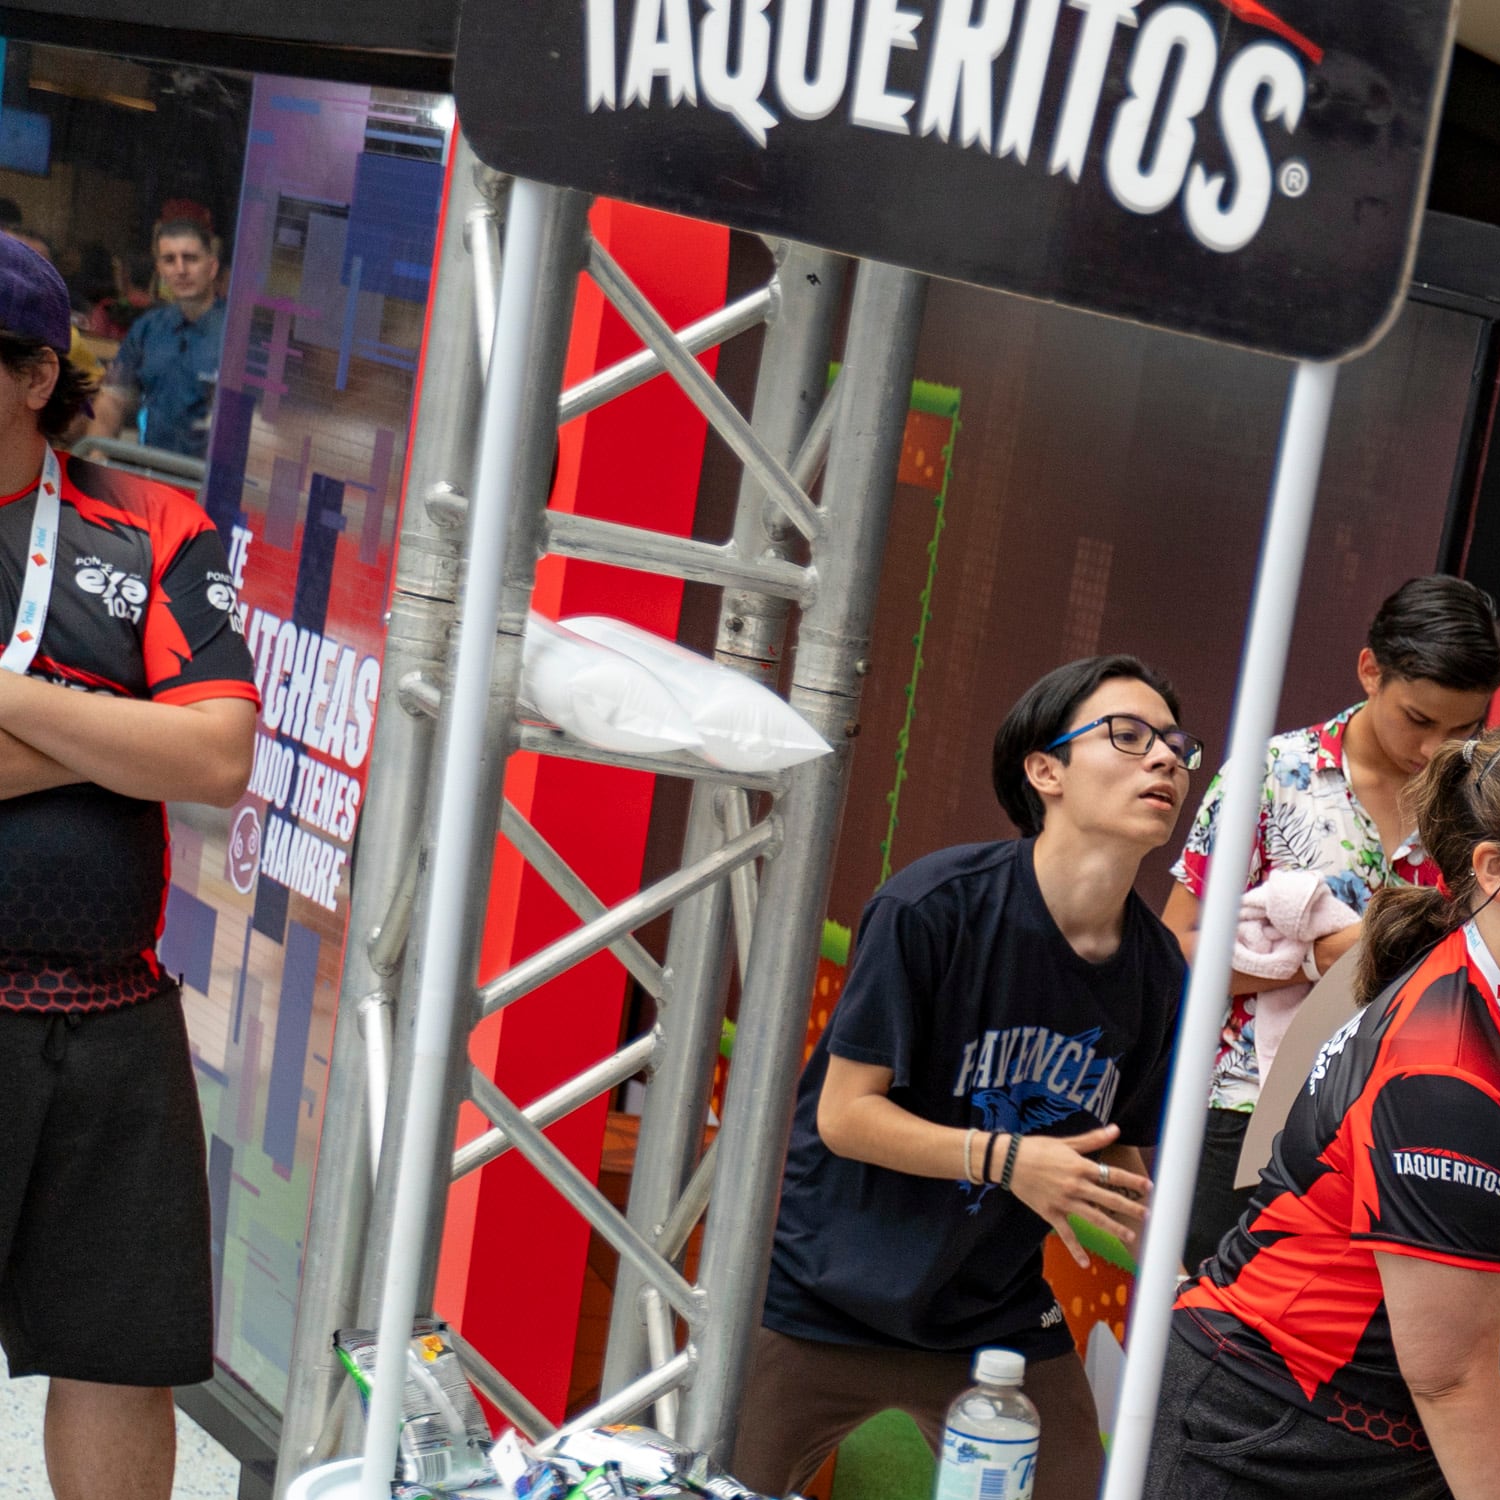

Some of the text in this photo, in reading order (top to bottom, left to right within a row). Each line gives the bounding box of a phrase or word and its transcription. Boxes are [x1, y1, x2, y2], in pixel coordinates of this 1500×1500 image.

[35, 526, 48, 550] intel
[24, 600, 38, 626] intel
[289, 752, 362, 843] TIENES
[261, 812, 347, 913] HAMBRE
